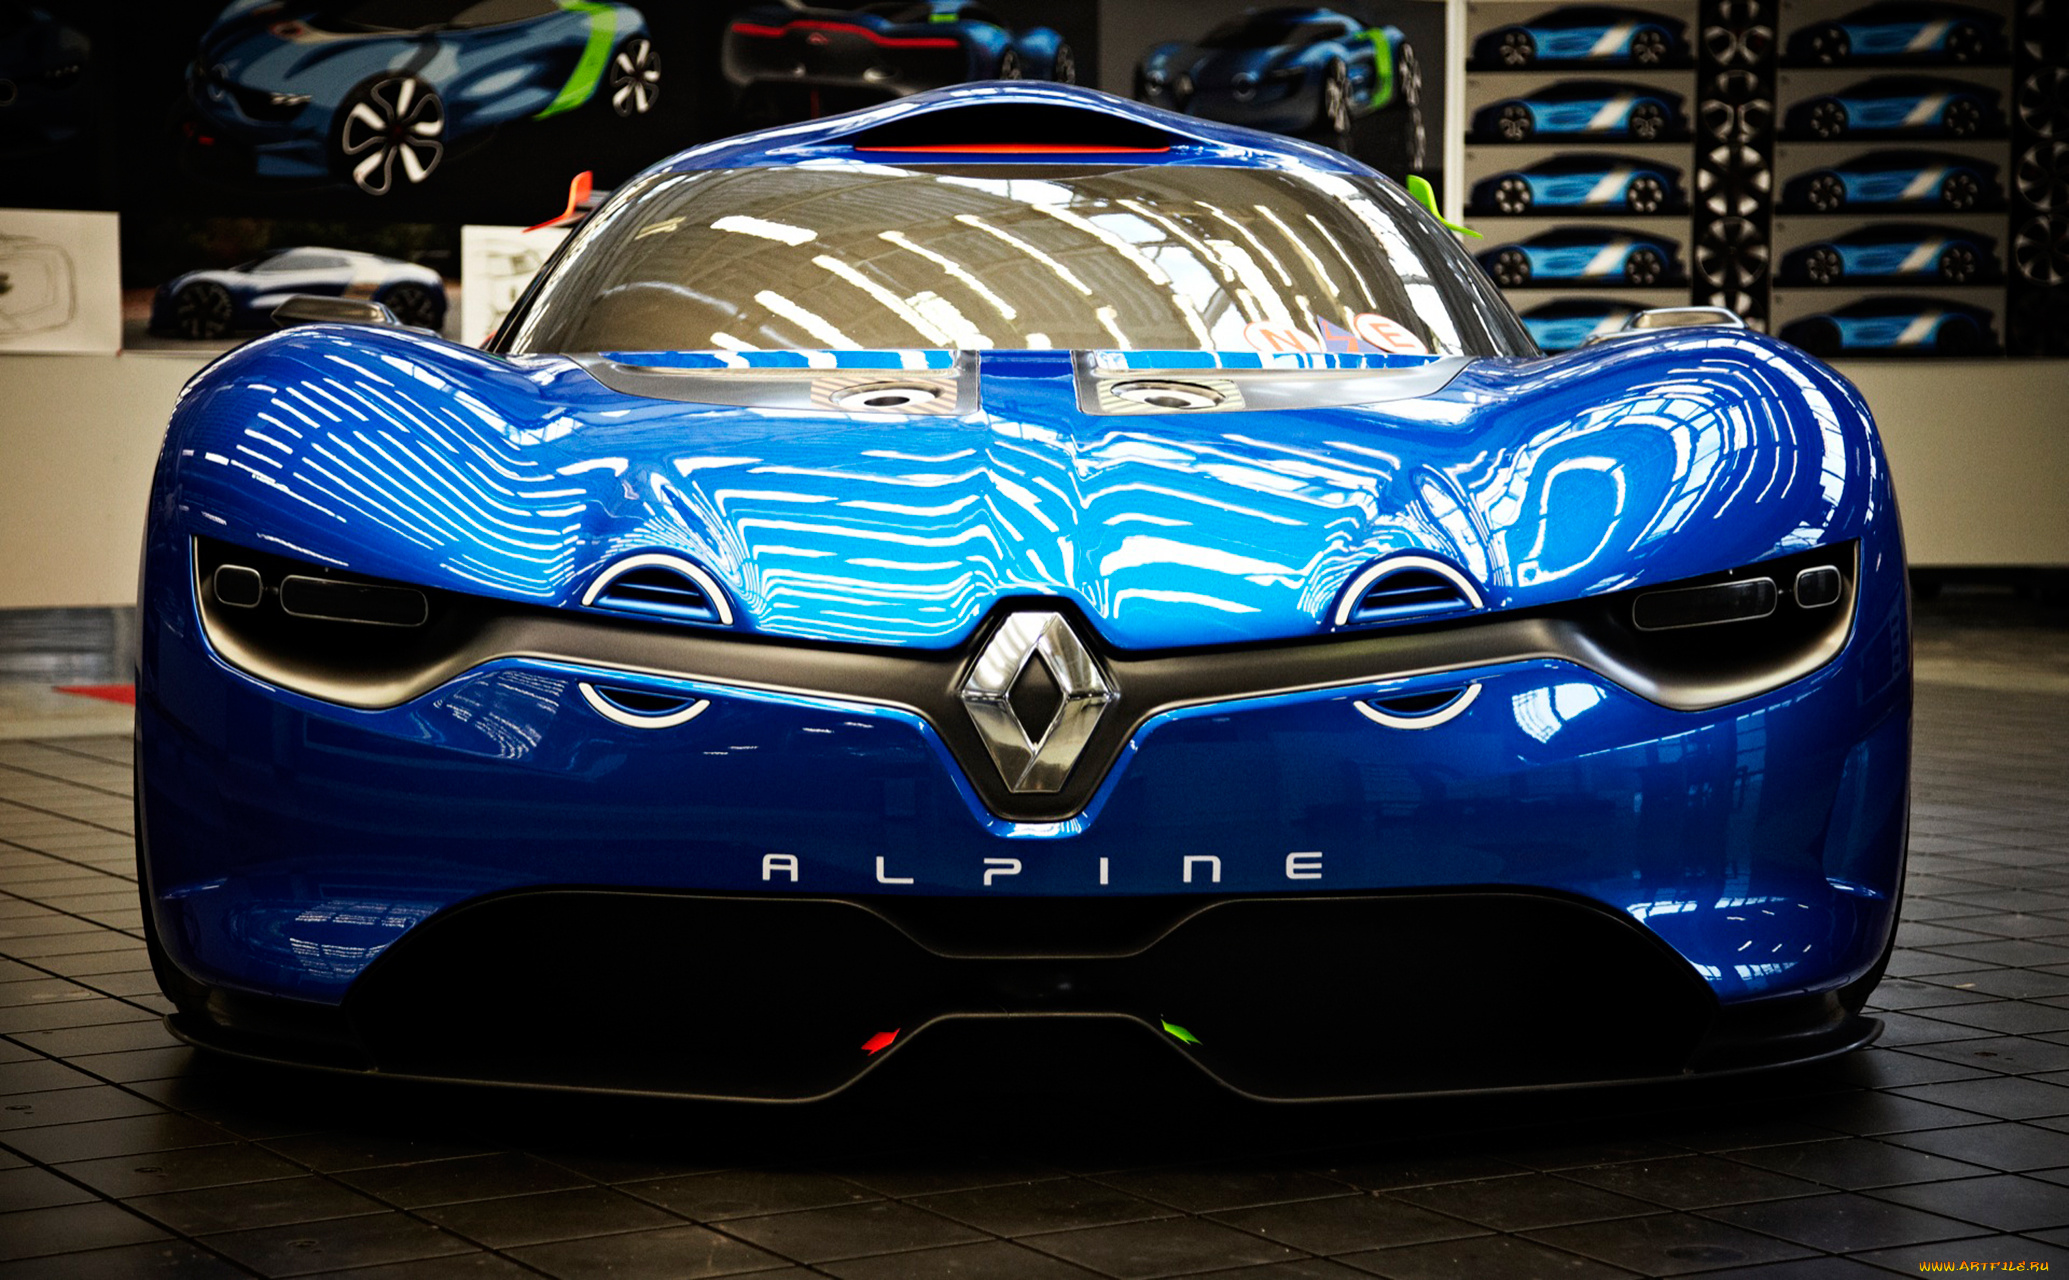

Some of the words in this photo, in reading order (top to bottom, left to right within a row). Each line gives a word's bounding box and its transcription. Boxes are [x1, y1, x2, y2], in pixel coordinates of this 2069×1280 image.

[1259, 328, 1307, 351] N
[1369, 322, 1416, 348] E
[762, 851, 1322, 886] ALPINE
